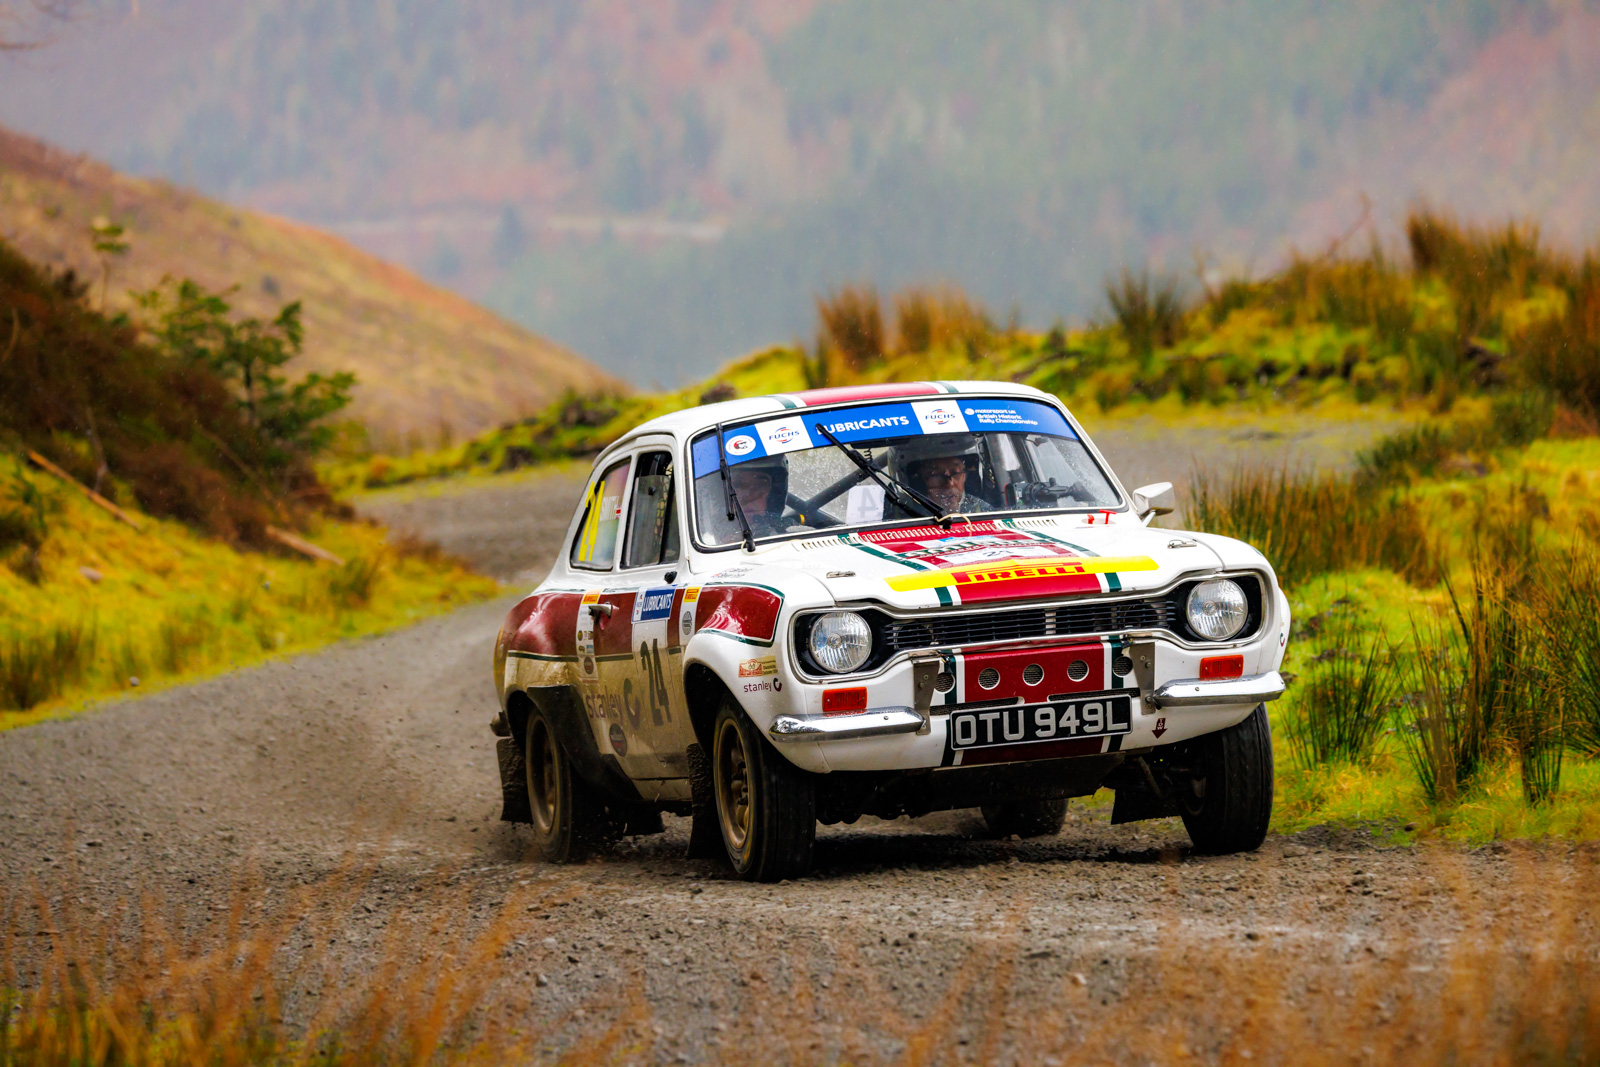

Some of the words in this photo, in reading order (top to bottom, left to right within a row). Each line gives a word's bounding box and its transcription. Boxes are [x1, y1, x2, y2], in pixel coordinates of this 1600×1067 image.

[769, 430, 800, 440] FUCHS
[951, 562, 1085, 584] PIRELLI
[643, 593, 673, 611] LUBRICANTS
[640, 638, 672, 727] 24
[743, 680, 772, 692] stanley
[585, 685, 624, 729] stanley
[955, 709, 1025, 746] OTU
[1034, 701, 1128, 738] 949L
[1156, 718, 1165, 730] TOW
